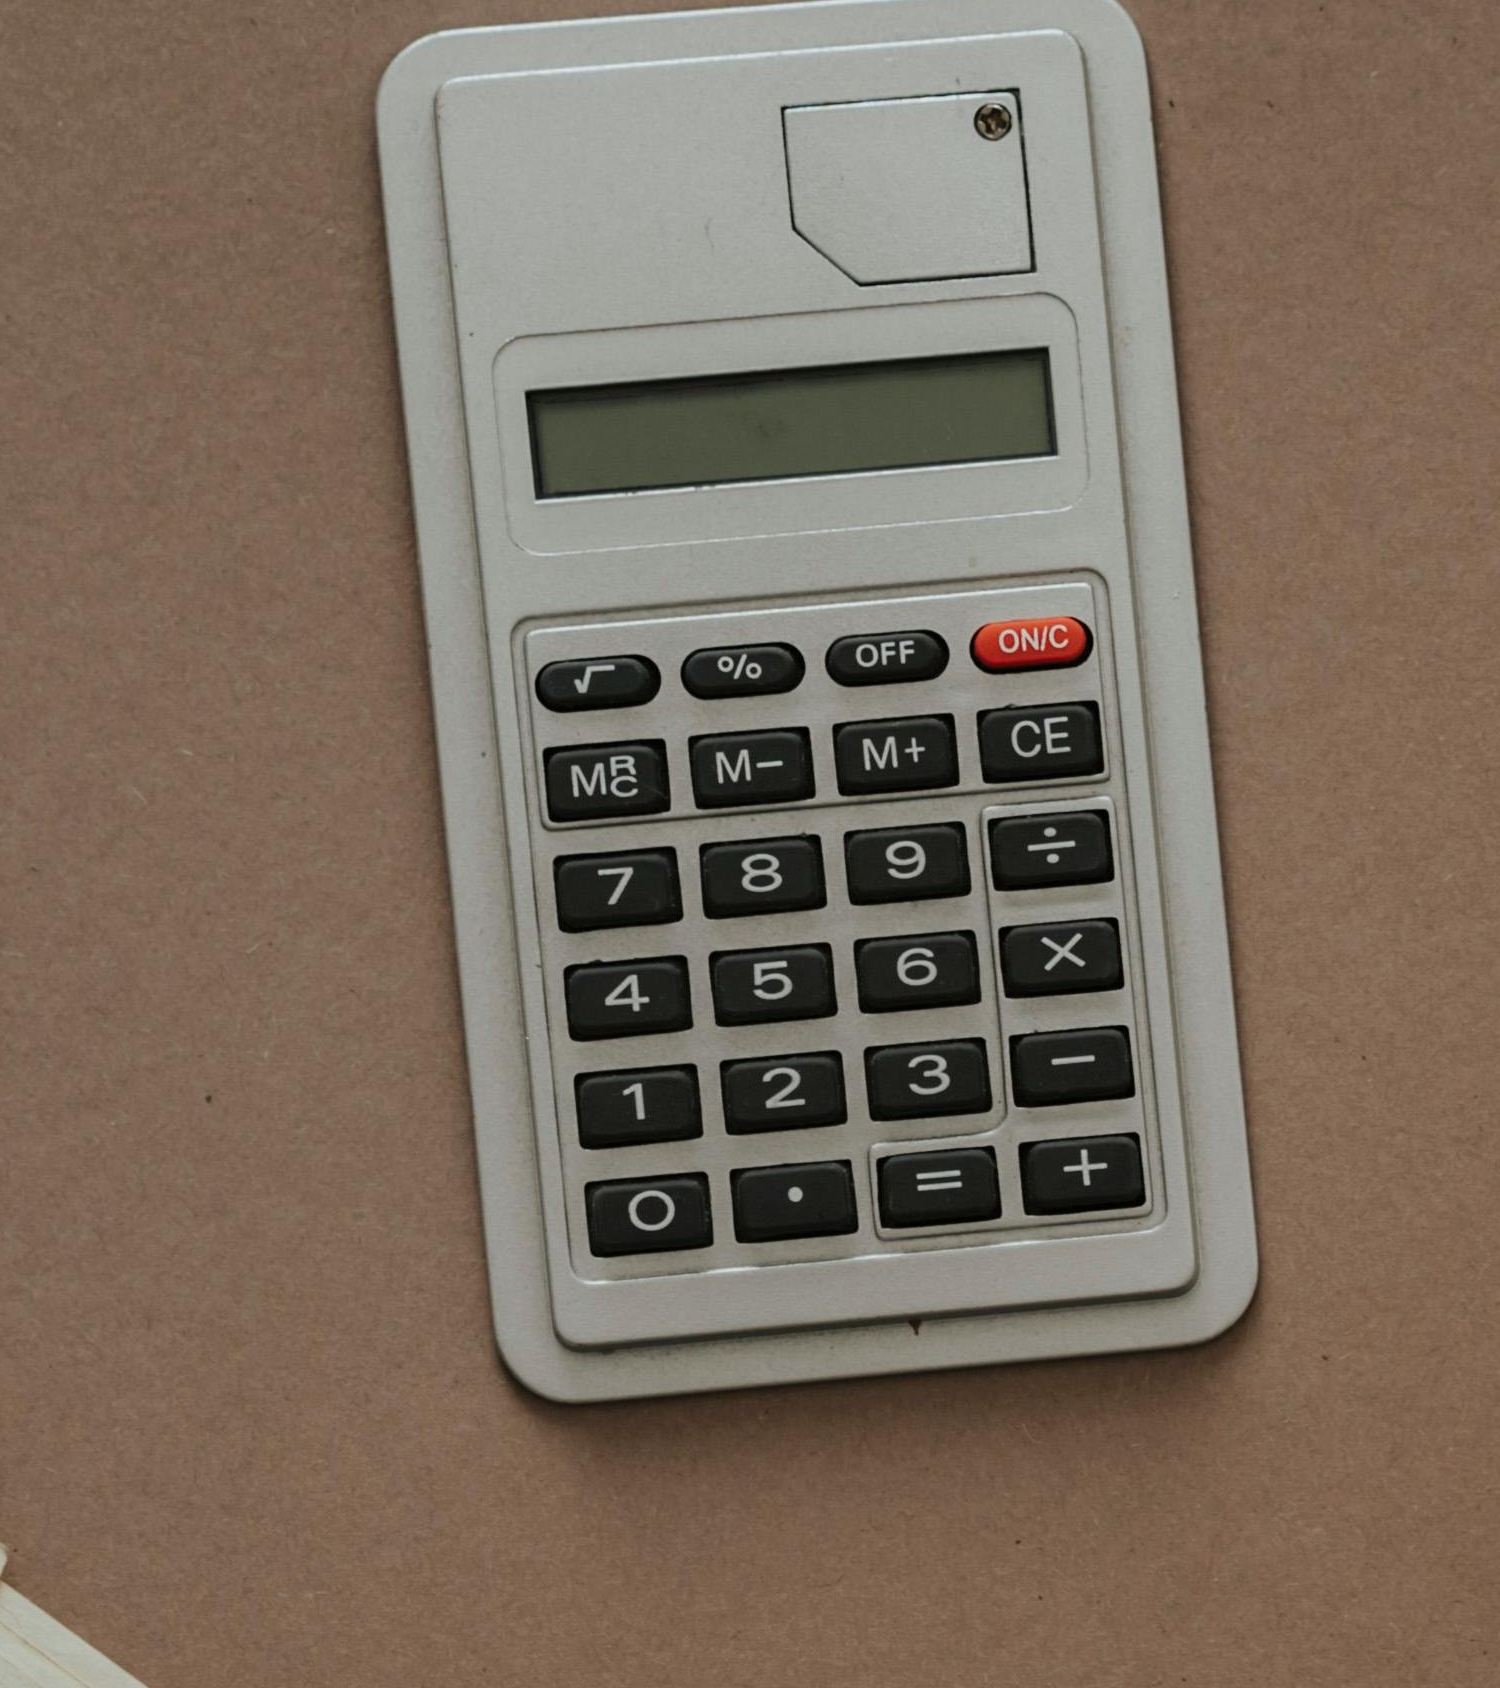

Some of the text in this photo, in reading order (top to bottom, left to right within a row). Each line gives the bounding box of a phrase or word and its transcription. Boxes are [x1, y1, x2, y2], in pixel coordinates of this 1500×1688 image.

[855, 640, 916, 668] OFF
[997, 625, 1069, 654] ON/C
[716, 654, 762, 682] %
[862, 736, 926, 771] M+
[1010, 717, 1072, 758] CE
[741, 853, 783, 893] 8
[885, 840, 927, 879] 9
[597, 867, 634, 906] 7
[752, 960, 793, 1000] 5
[897, 947, 938, 986] 6
[604, 974, 650, 1012] 4
[762, 1068, 806, 1109] 2
[907, 1055, 951, 1096] 3
[622, 1083, 646, 1120] 1
